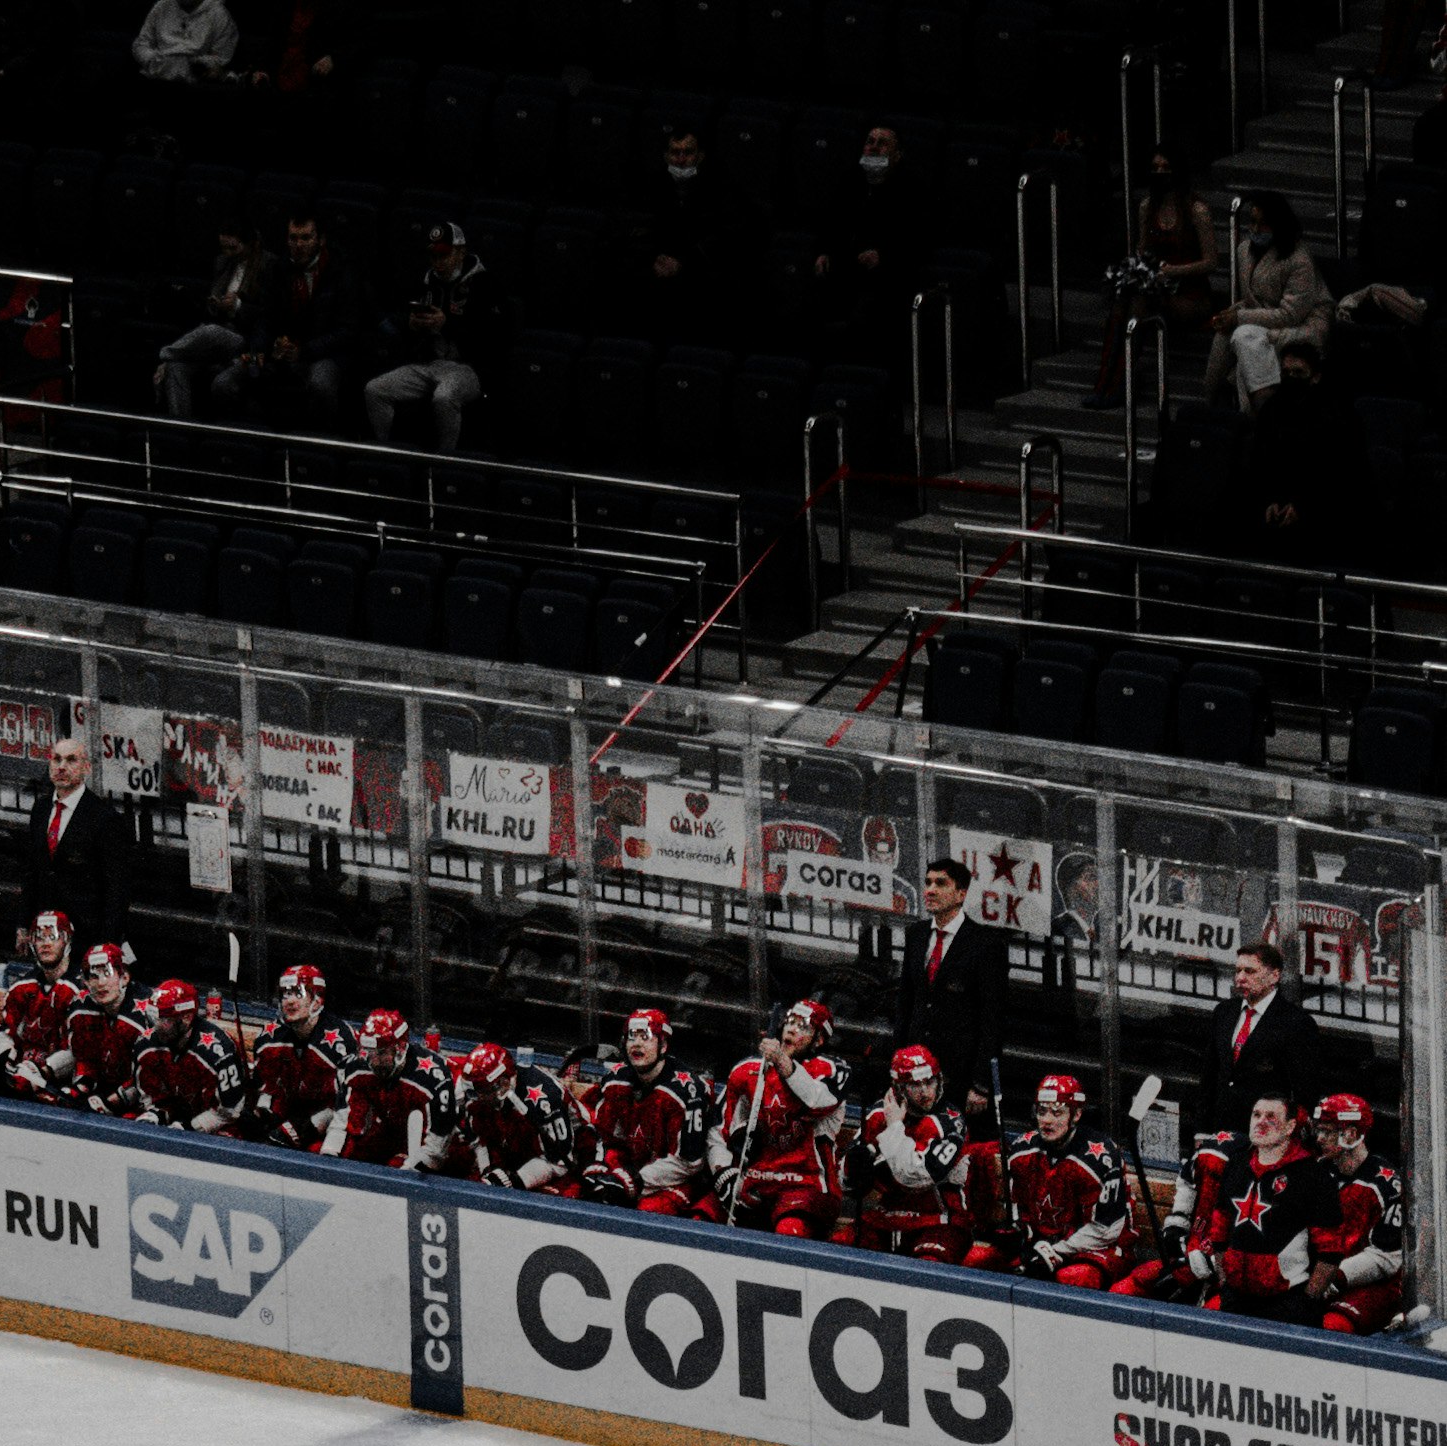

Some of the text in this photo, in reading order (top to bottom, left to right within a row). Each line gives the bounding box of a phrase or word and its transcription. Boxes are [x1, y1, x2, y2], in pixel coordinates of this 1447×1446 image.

[128, 761, 161, 792] GO!
[520, 768, 544, 796] 23
[317, 804, 343, 824] ВАС
[447, 807, 536, 843] KHL.RU
[775, 828, 823, 852] RYKOV
[799, 862, 882, 895] согаз
[1137, 912, 1235, 951] KHL.RU
[218, 1067, 242, 1092] 22
[5, 1189, 100, 1249] RUN
[130, 1193, 286, 1298] SAP
[1112, 1362, 1339, 1441] ОФИЦИАЛЬНЫЙ
